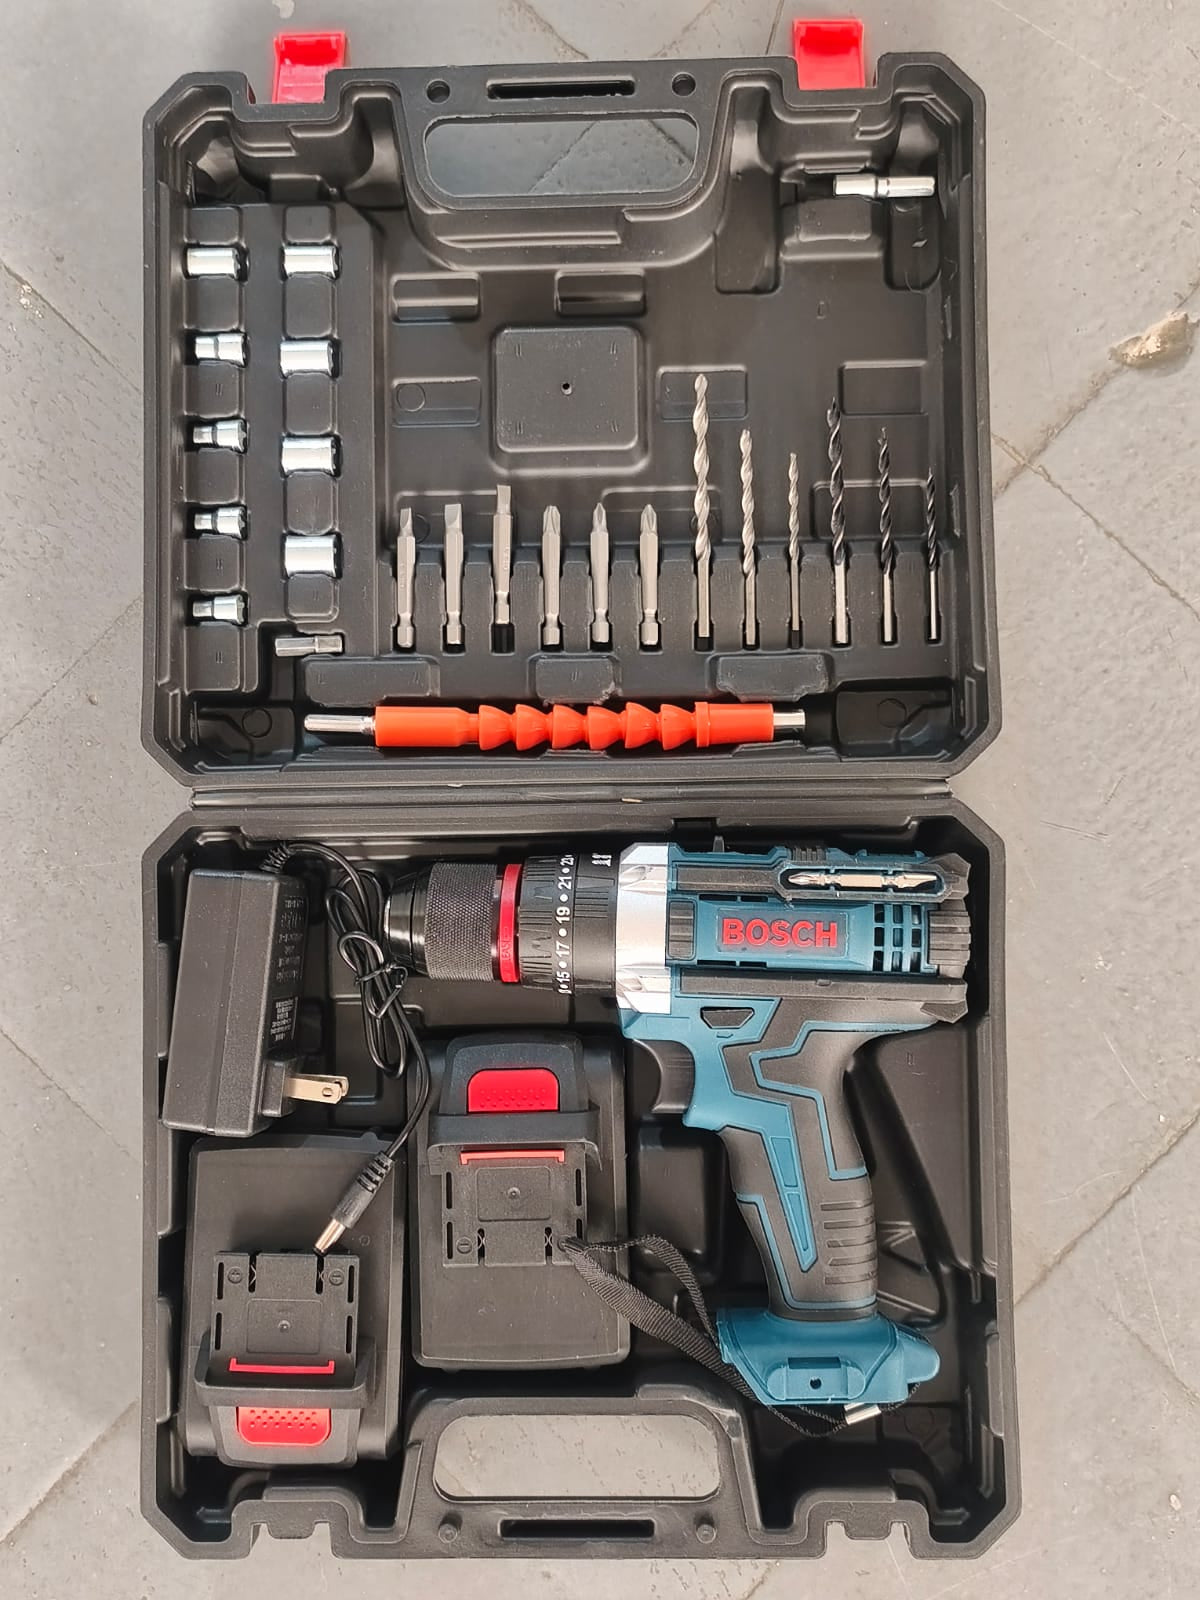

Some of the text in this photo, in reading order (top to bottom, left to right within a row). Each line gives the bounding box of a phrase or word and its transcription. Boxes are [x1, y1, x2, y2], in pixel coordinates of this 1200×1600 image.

[558, 876, 572, 890] 21
[556, 906, 571, 923] 19
[722, 918, 838, 948] BOSCH
[556, 941, 570, 957] 17
[556, 971, 571, 982] 15
